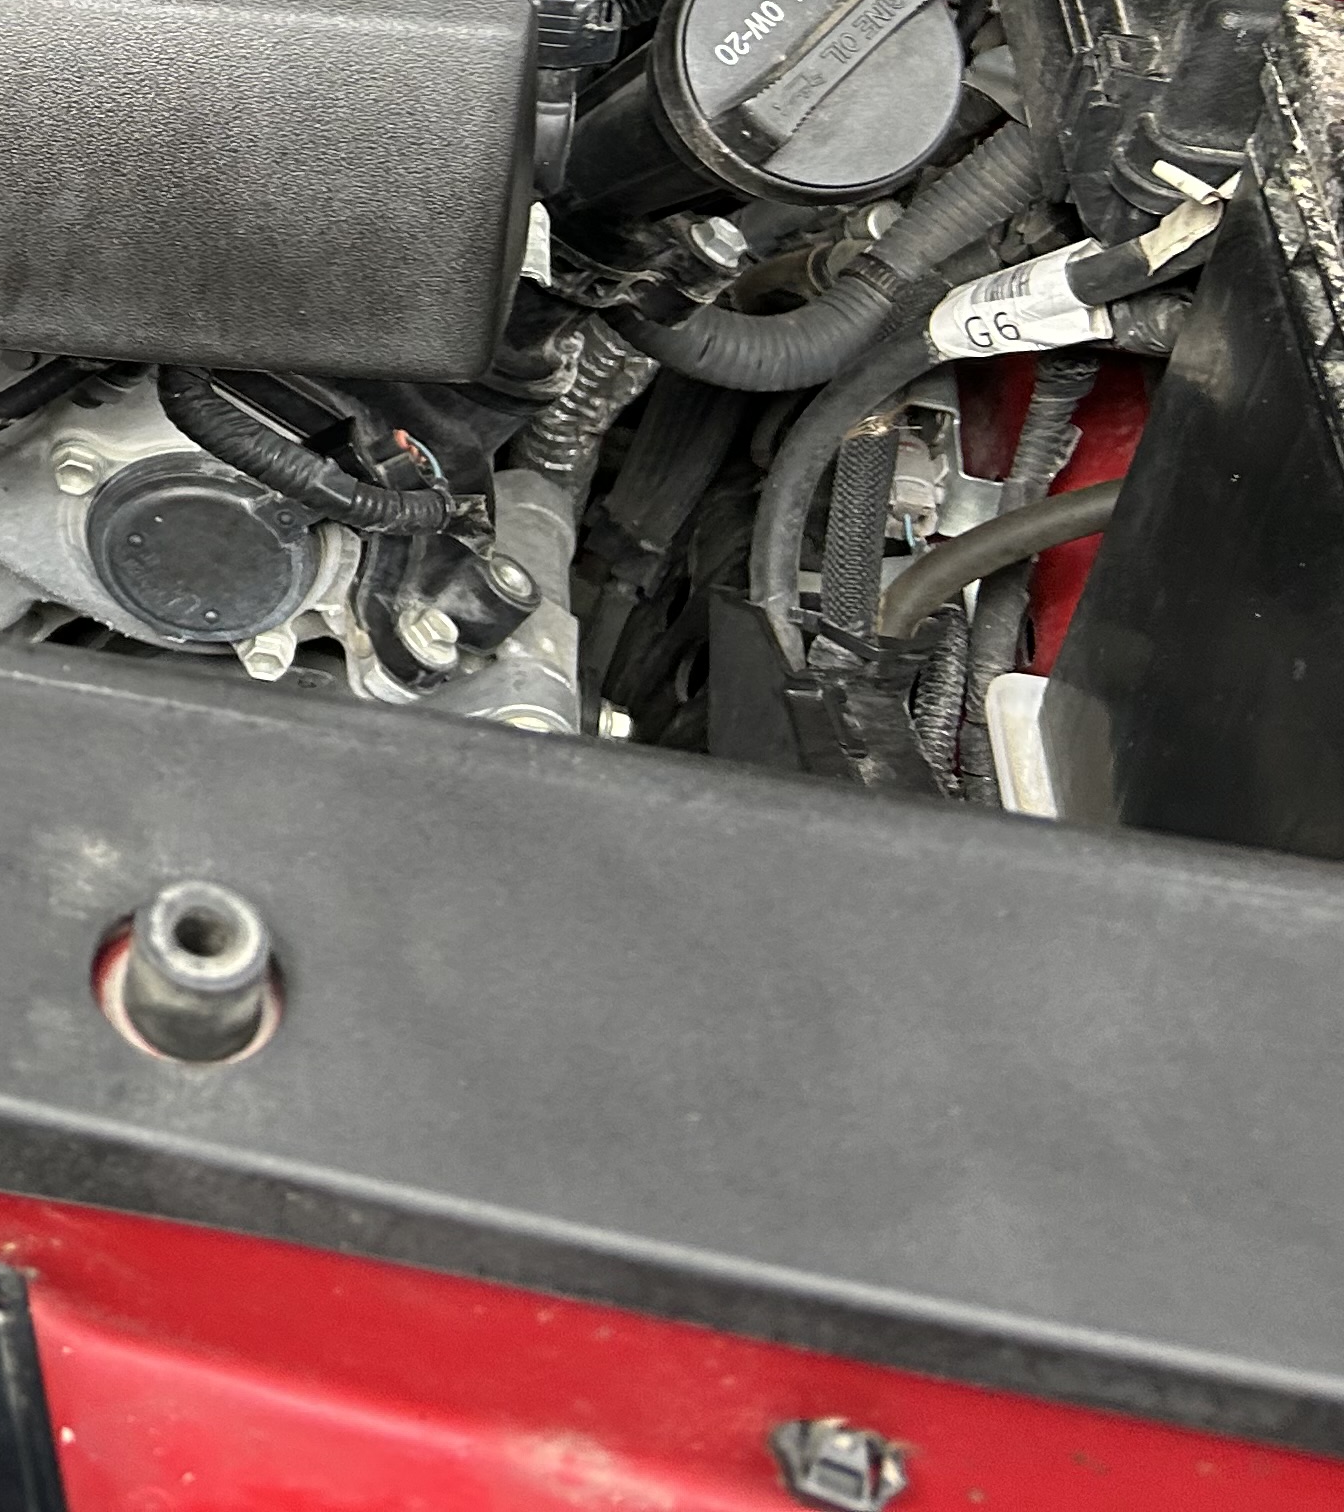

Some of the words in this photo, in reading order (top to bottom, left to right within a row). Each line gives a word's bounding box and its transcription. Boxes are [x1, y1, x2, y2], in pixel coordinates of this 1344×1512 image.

[714, 0, 785, 66] 0W-20
[820, 34, 857, 66] OIL
[964, 311, 1021, 348] G6
